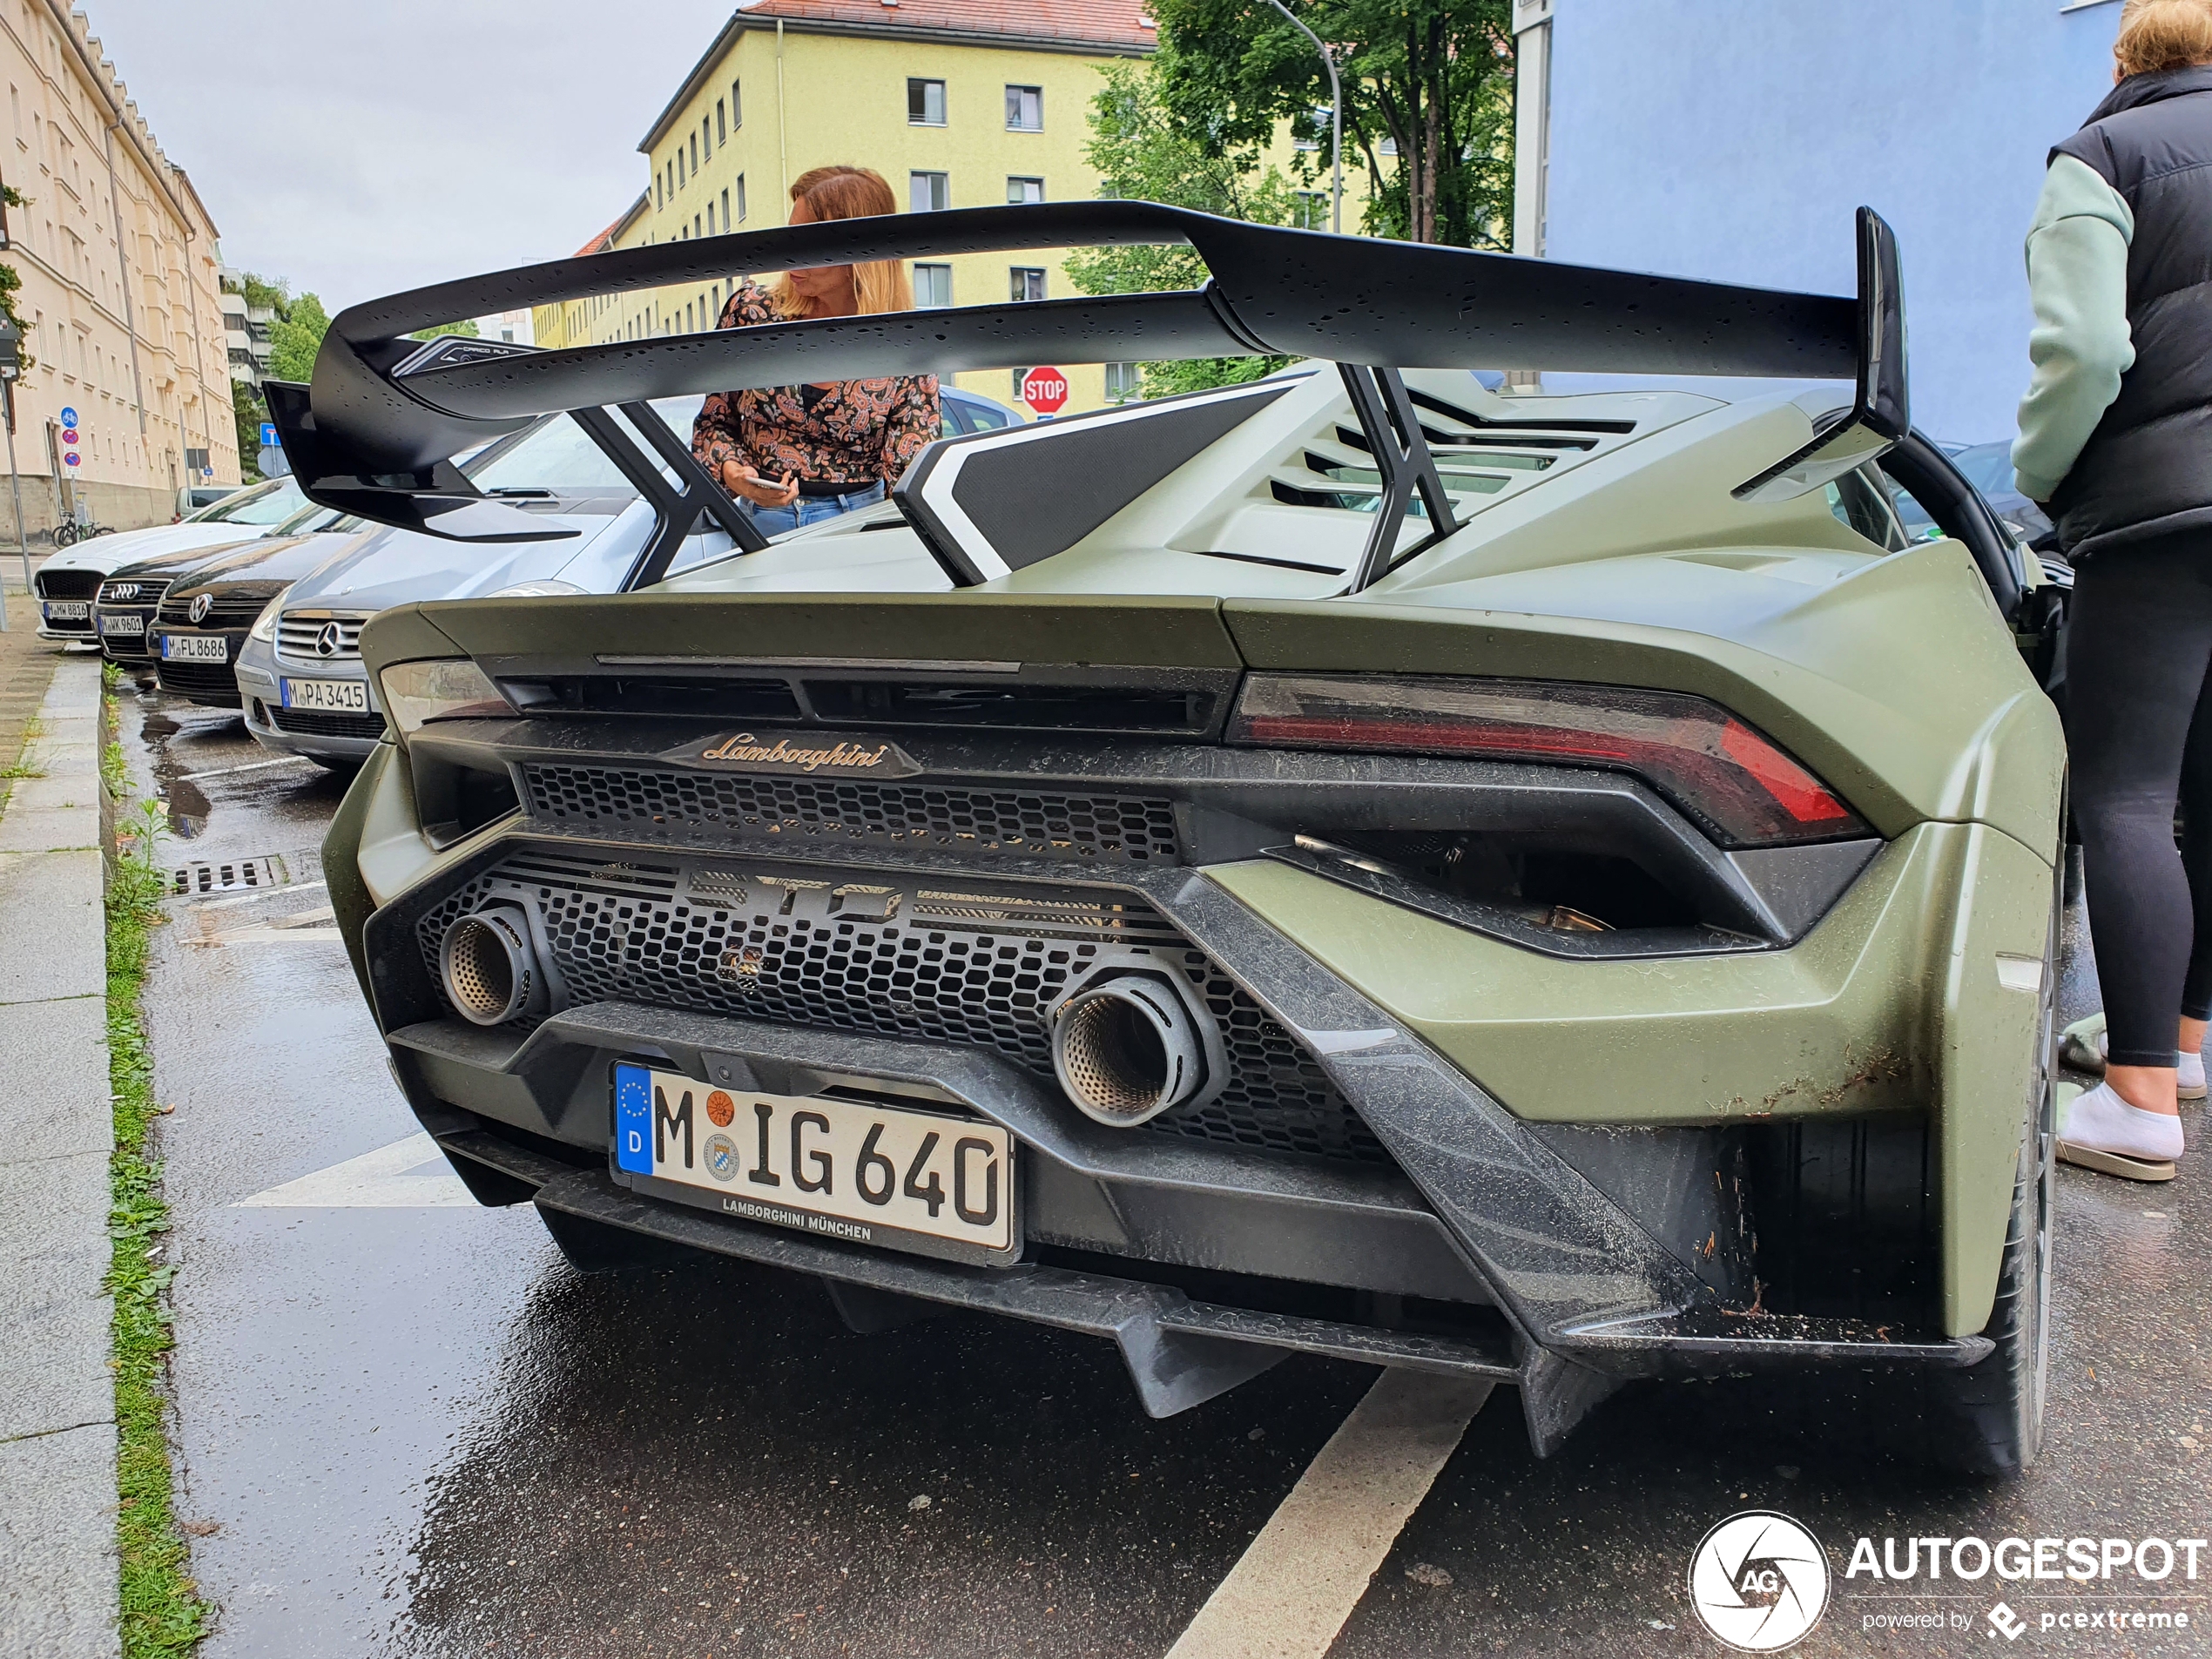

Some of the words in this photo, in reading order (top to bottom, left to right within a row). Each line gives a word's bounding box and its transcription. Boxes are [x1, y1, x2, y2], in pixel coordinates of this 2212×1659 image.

[1026, 380, 1065, 401] STOP
[68, 604, 86, 616] 8816
[122, 617, 143, 631] 9601
[169, 638, 177, 657] M
[181, 638, 195, 656] FL
[197, 639, 225, 657] 8686
[288, 682, 299, 705] M
[305, 683, 324, 706] PA
[326, 685, 363, 708] 3415
[703, 732, 884, 772] Lamborghini
[684, 870, 904, 925] STO
[629, 1130, 642, 1153] D
[655, 1085, 694, 1169] M
[749, 1103, 833, 1196] IG
[855, 1122, 998, 1227] 640
[723, 1197, 805, 1227] LAMBORGHINI
[808, 1216, 872, 1241] MÜNCHEN
